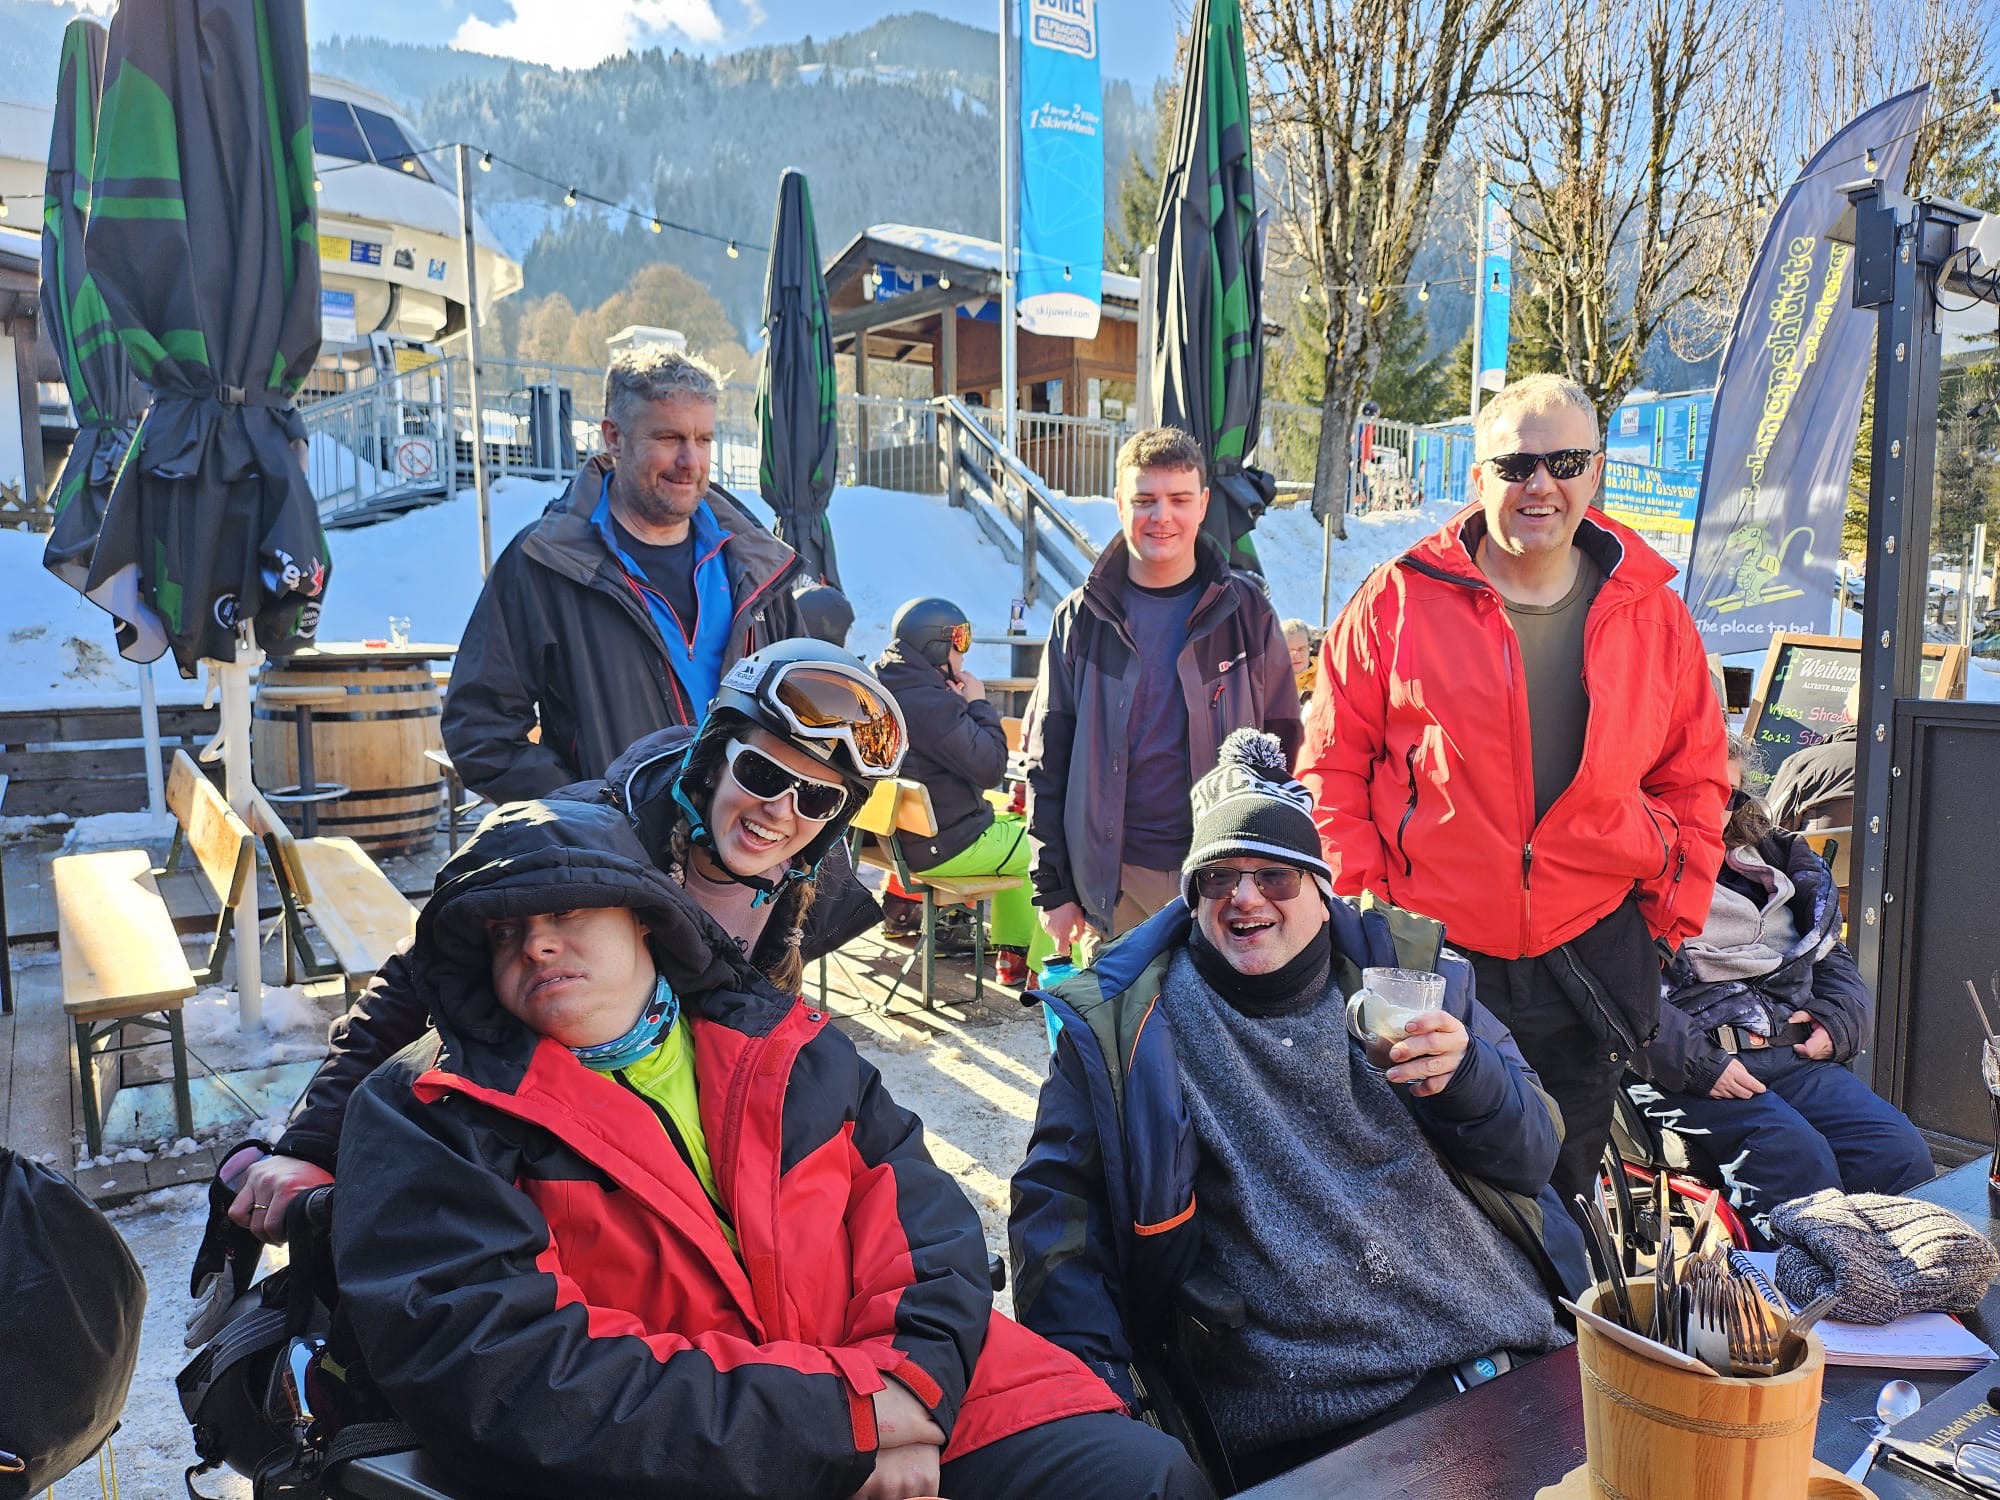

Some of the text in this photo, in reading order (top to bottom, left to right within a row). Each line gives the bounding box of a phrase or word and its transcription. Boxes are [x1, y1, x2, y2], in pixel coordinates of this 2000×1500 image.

[1606, 463, 1639, 479] PISTEN
[1633, 480, 1653, 494] UHR
[1694, 619, 1814, 636] The place to be!
